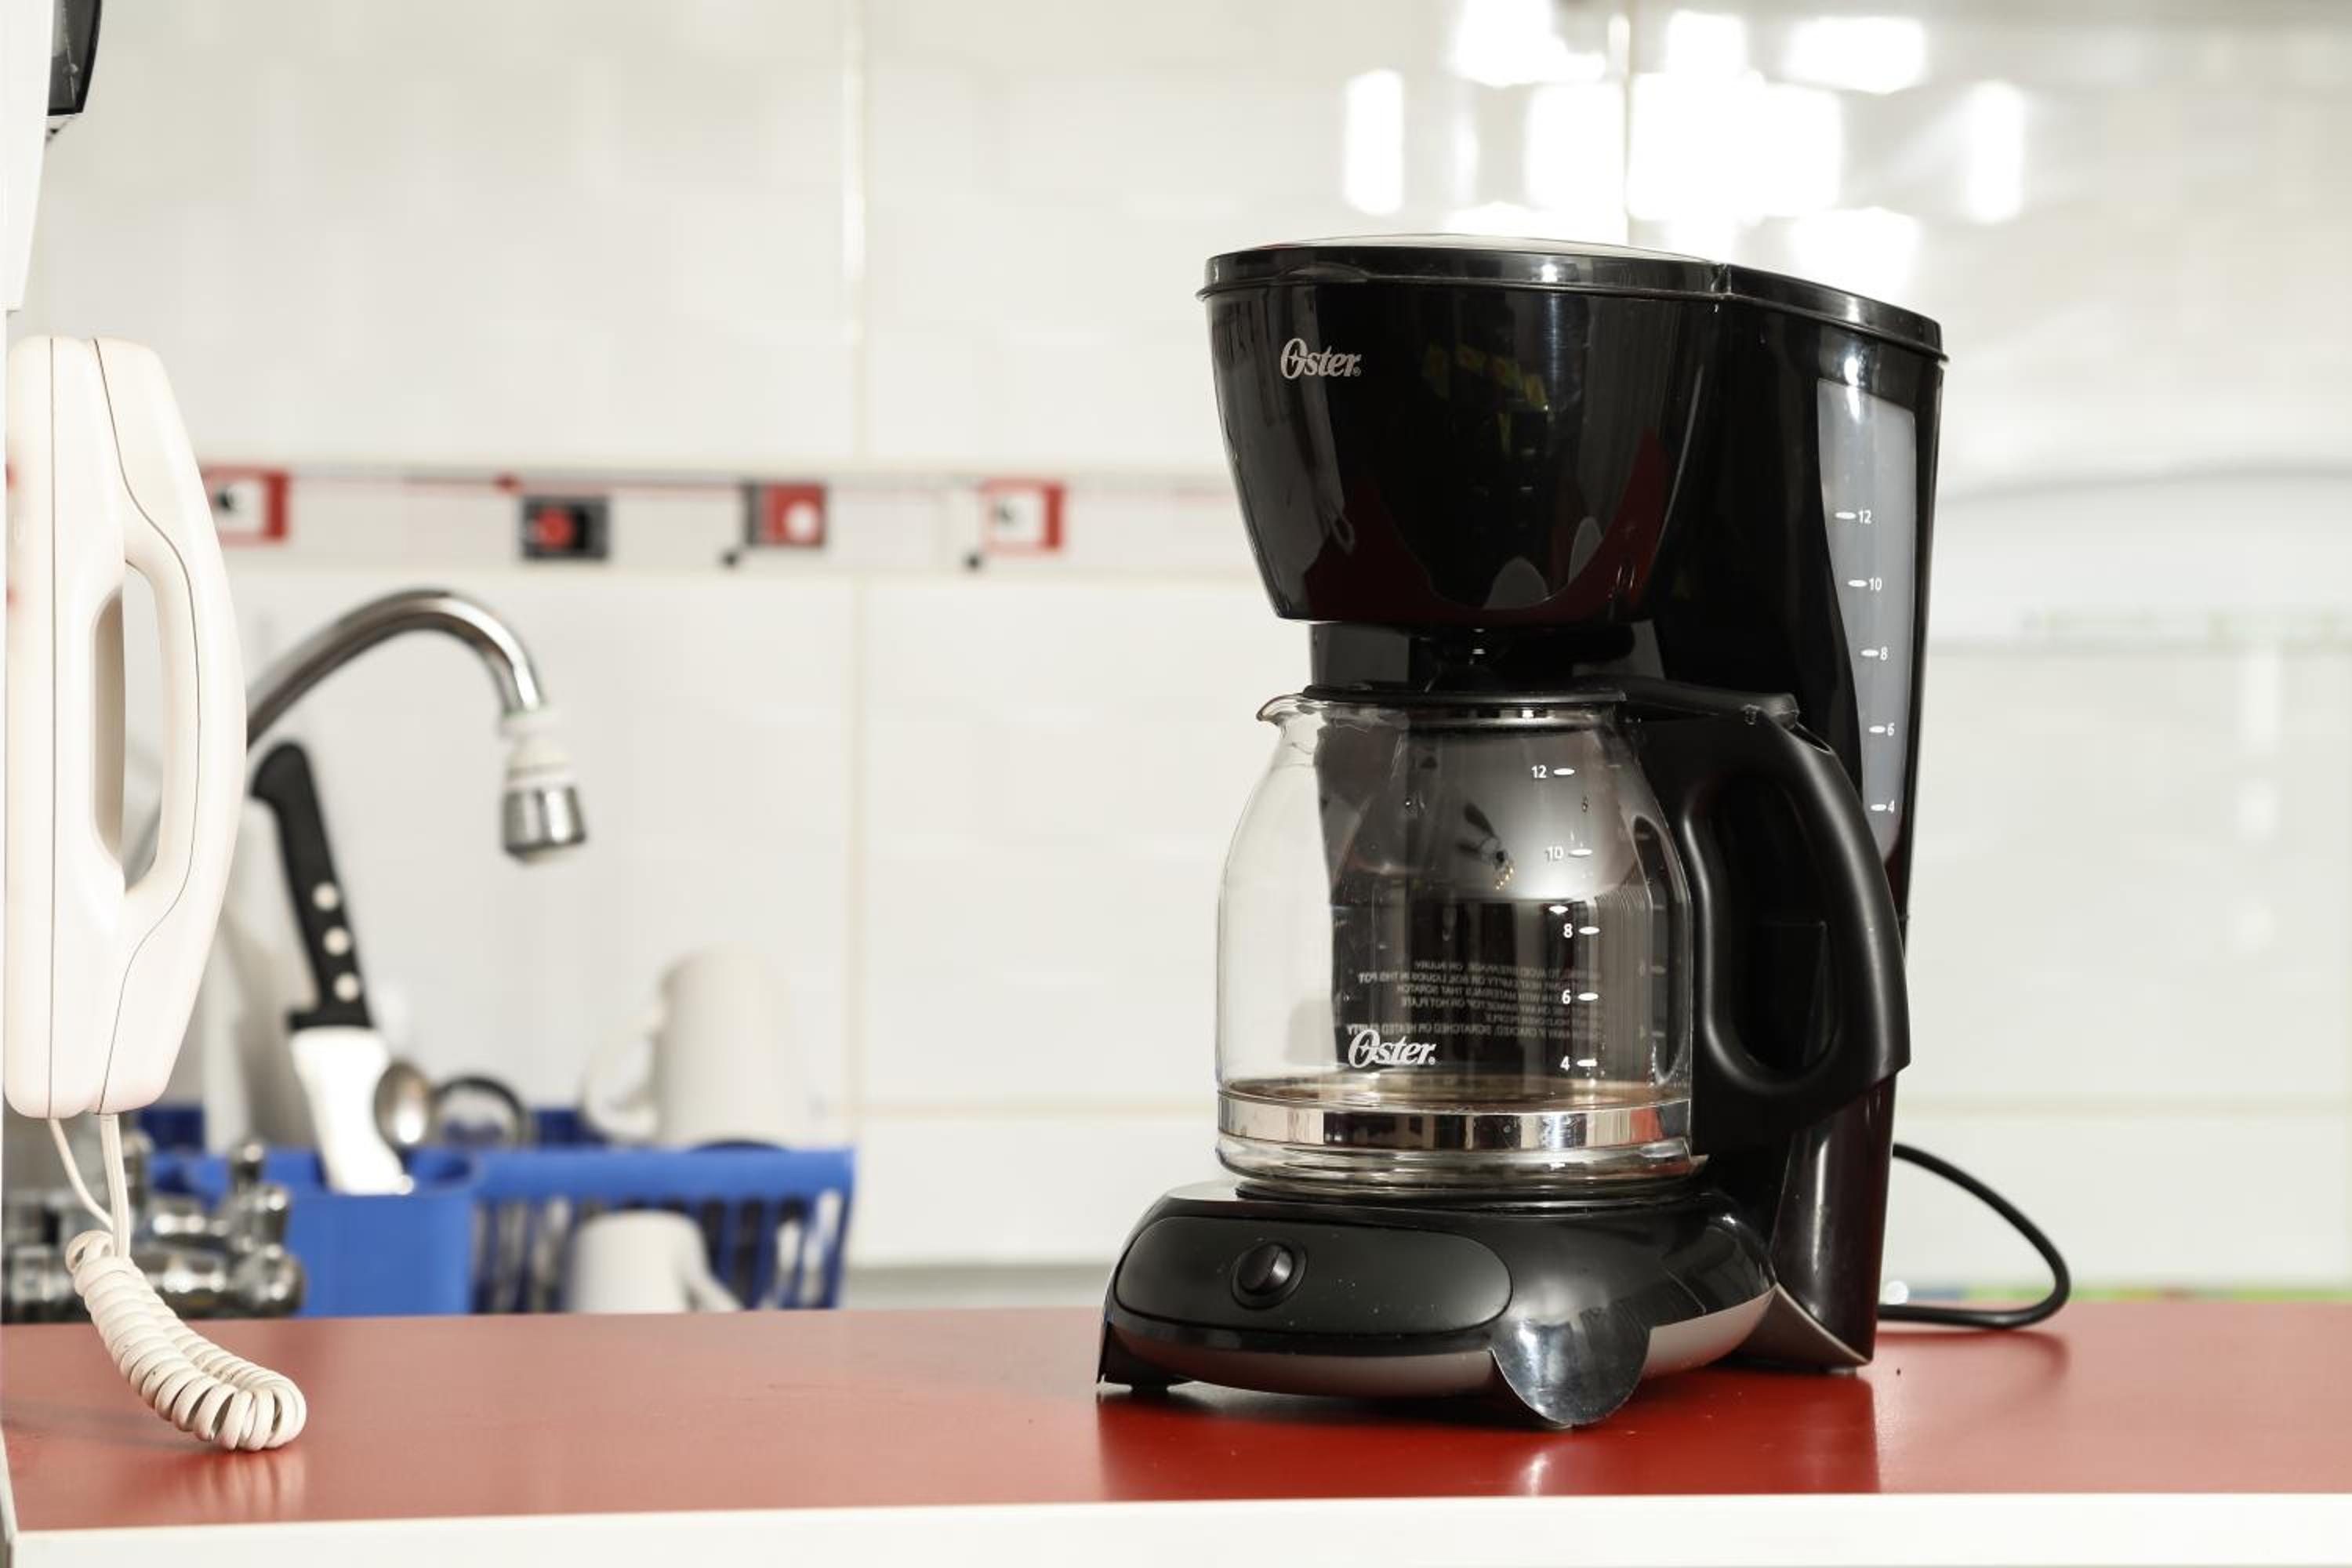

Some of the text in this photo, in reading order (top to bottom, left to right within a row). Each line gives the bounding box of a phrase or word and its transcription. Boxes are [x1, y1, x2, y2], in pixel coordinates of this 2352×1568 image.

[1857, 509, 1872, 524] 12
[1868, 577, 1882, 592] 10
[1879, 645, 1889, 661] 8
[1887, 722, 1895, 737] 6
[1531, 764, 1547, 779] 12
[1887, 800, 1895, 814] 4
[1545, 845, 1564, 861] 10
[1563, 923, 1573, 938] 8
[1561, 989, 1571, 1004] 6
[1560, 1055, 1570, 1071] 4
